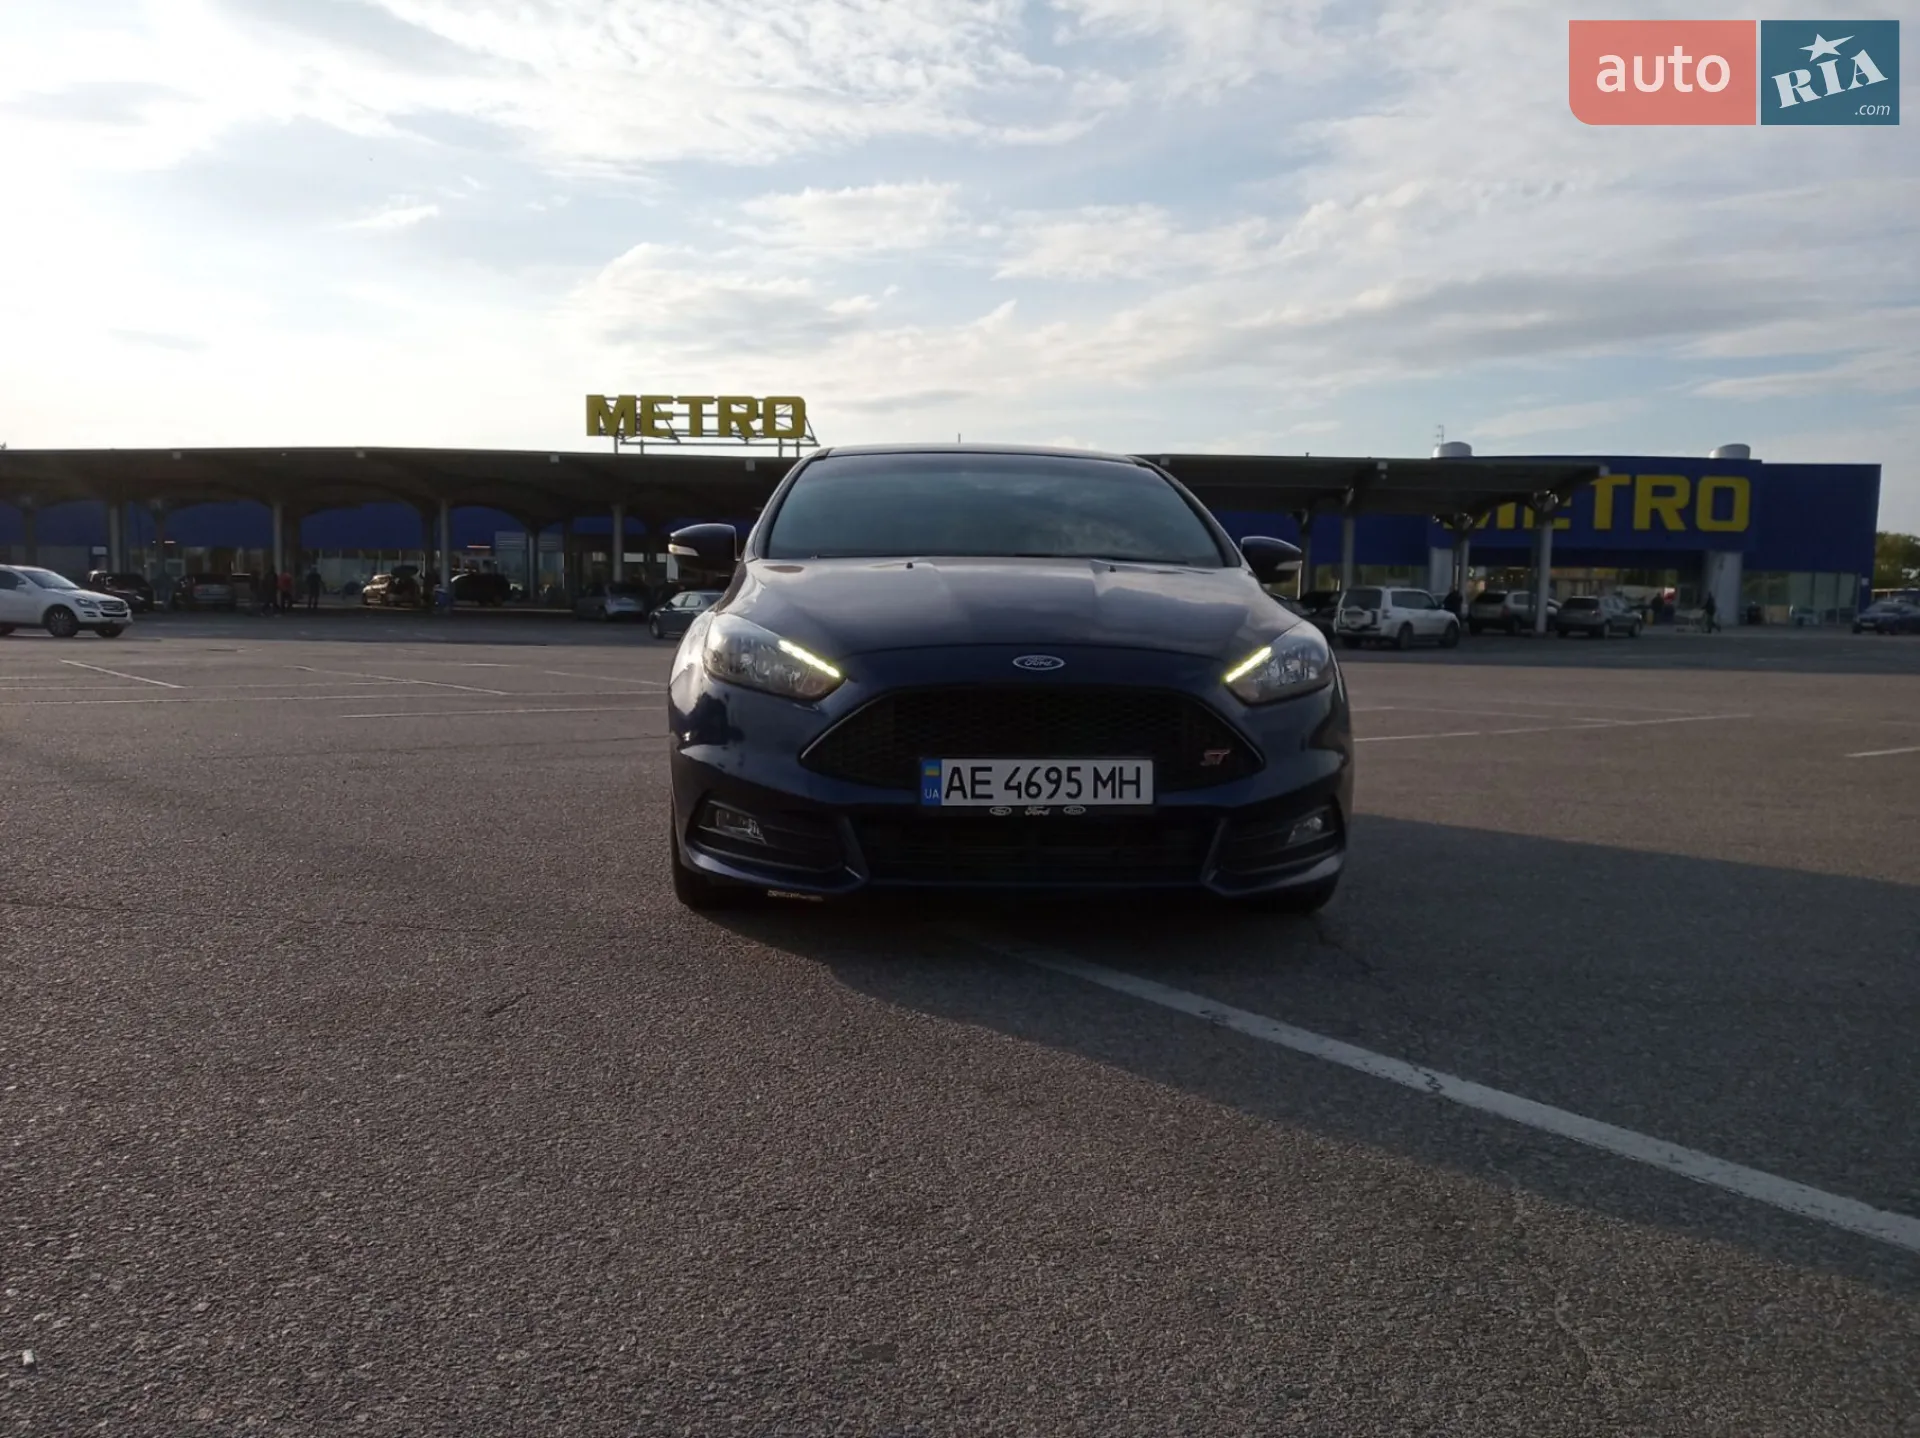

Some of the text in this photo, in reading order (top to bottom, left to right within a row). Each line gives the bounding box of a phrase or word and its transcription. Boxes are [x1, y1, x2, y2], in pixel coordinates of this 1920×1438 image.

[586, 394, 806, 439] METRO
[924, 789, 940, 799] UA
[944, 765, 1142, 800] AE 4695 MH
